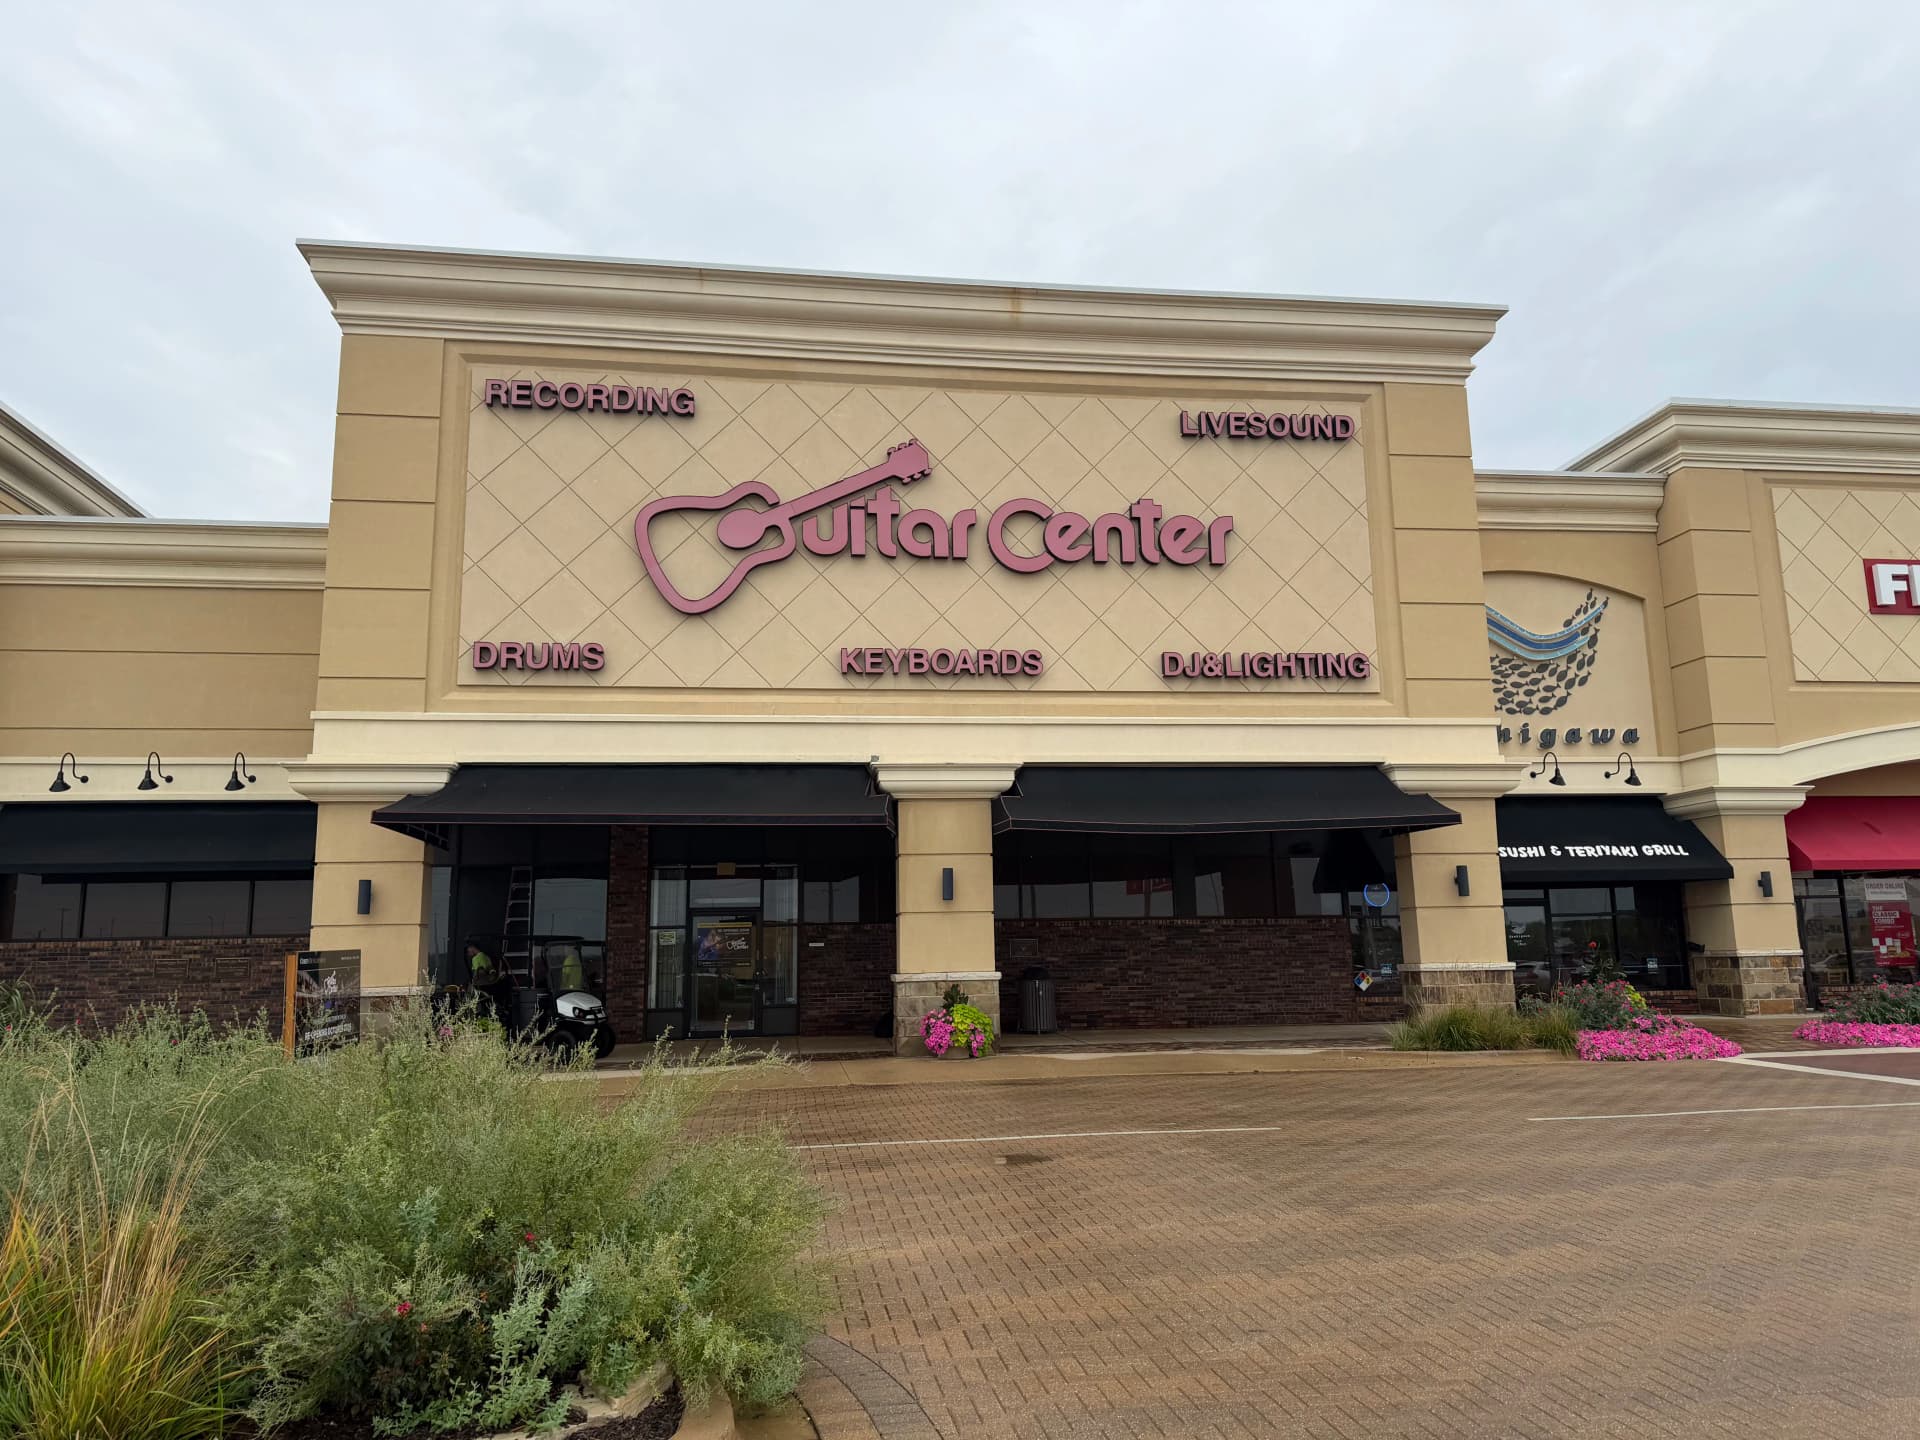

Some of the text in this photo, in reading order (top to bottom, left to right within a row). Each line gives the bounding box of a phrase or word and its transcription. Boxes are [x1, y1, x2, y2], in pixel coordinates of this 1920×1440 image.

[484, 378, 696, 416] RECORDING
[1180, 410, 1355, 441] LIVESOUND
[634, 438, 1233, 615] Guitar Center
[472, 641, 605, 672] DRUMS
[840, 647, 1043, 678] KEYBOARDS
[1162, 650, 1371, 680] DJ&LIGHTING
[1498, 844, 1690, 858] SUSHI & TERIYAKI GRILL
